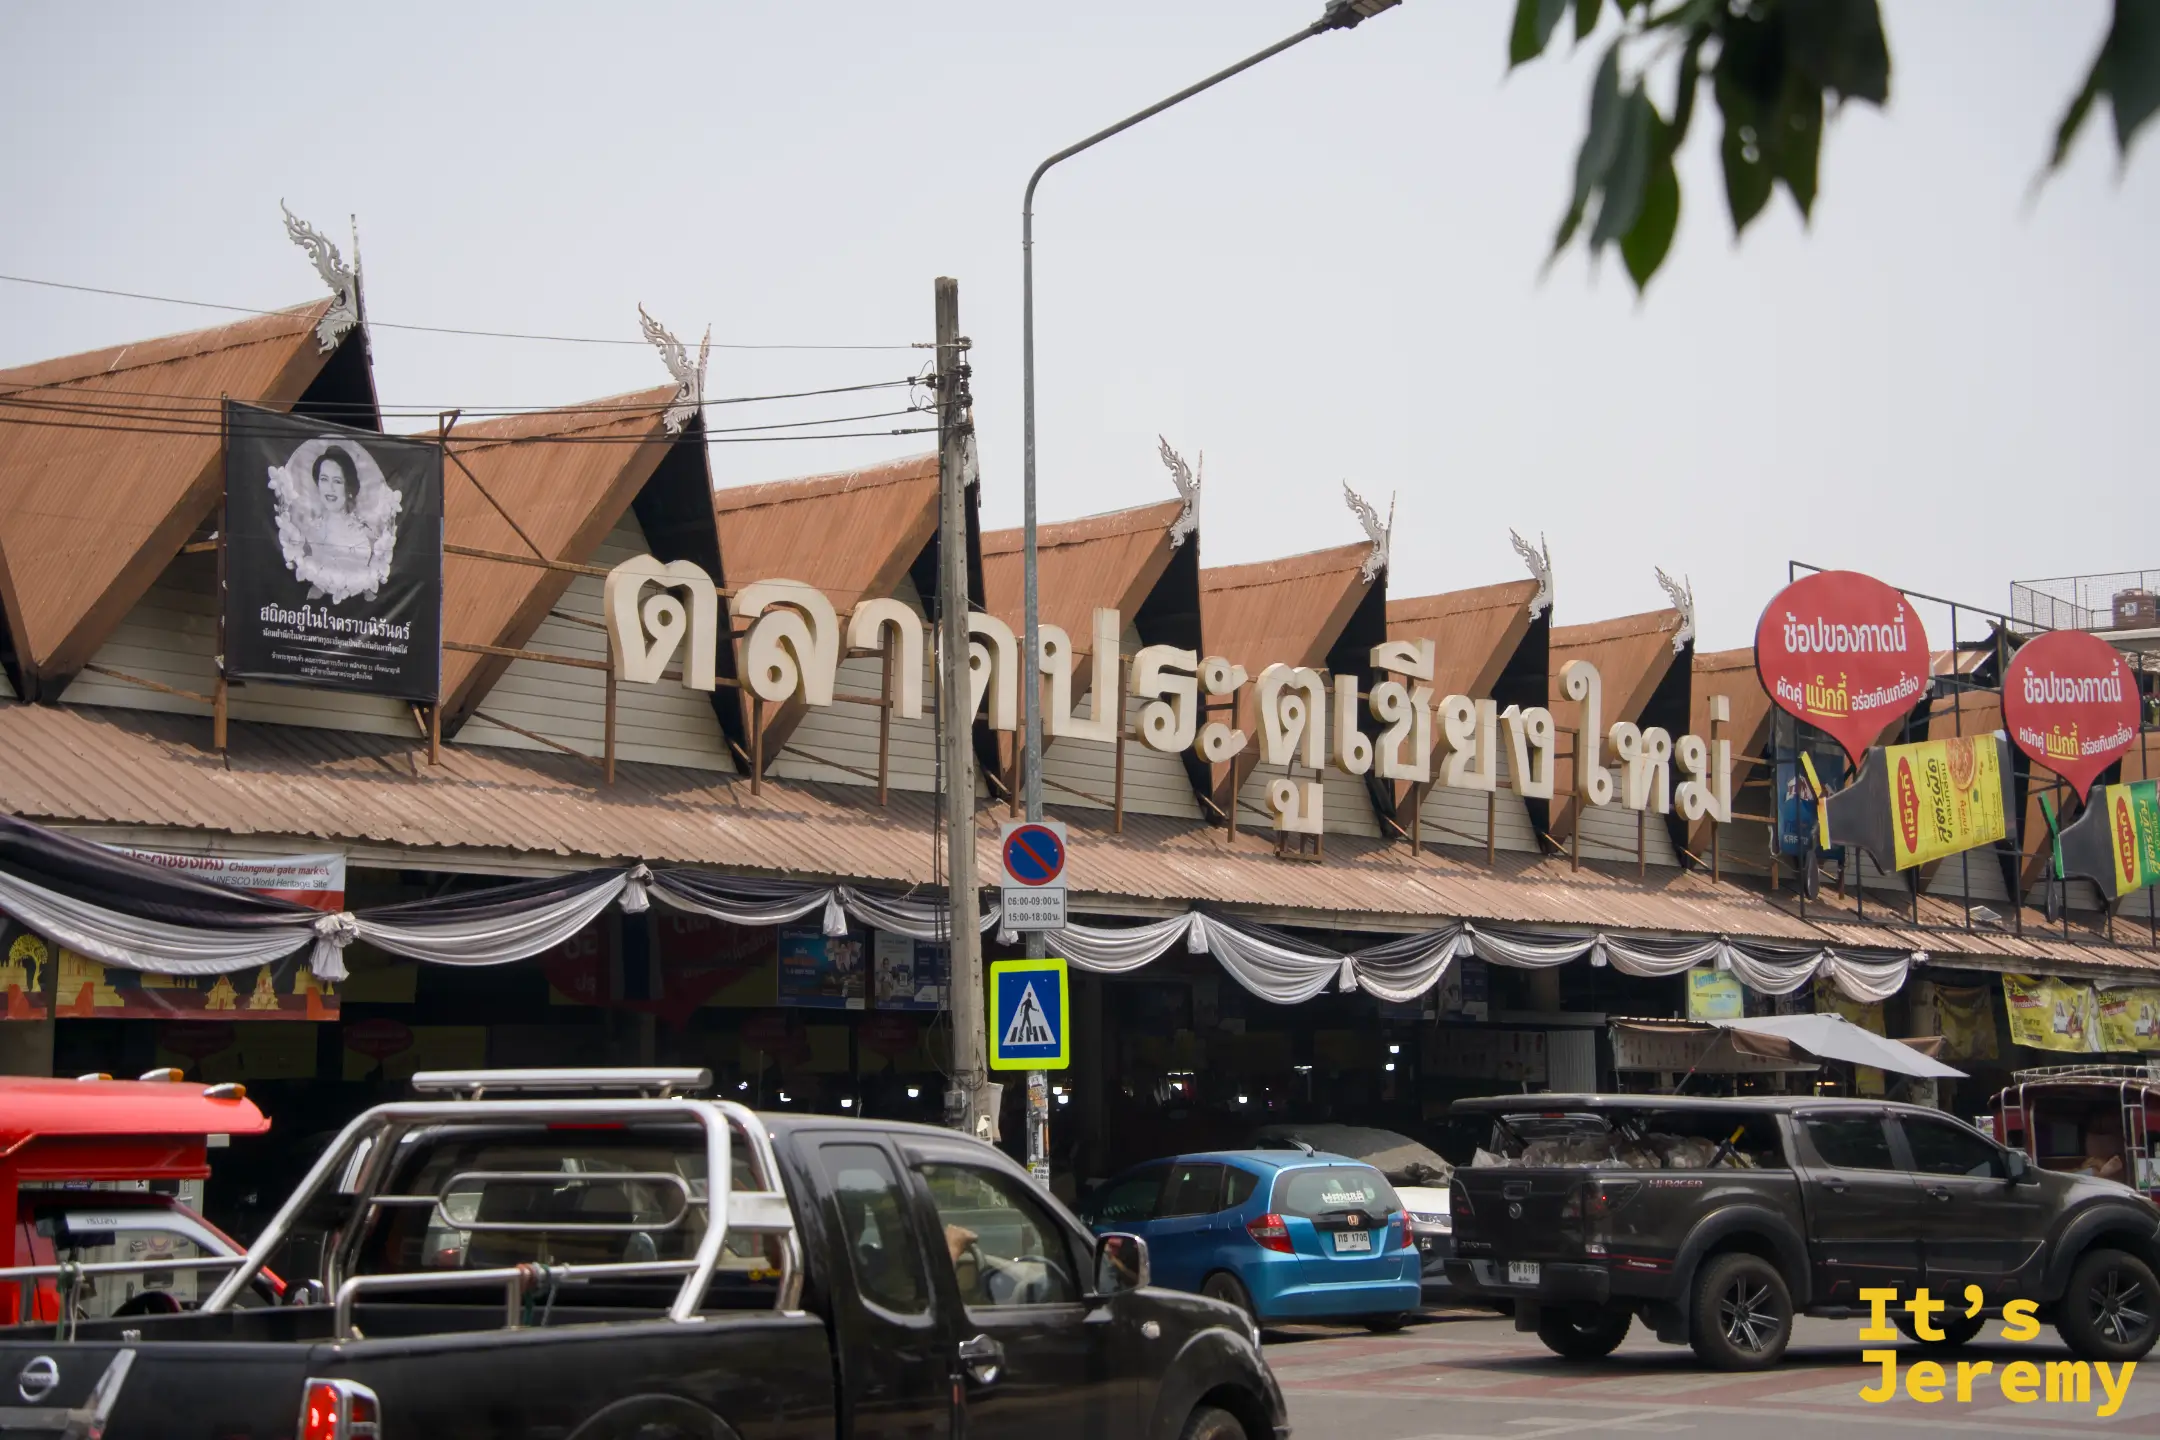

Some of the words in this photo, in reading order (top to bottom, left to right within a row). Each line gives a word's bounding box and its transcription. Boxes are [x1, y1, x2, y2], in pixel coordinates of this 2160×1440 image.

[1783, 603, 1907, 653] ช้อปของกาดนี้
[1805, 671, 1848, 711] แม็กกี้
[2023, 658, 2122, 704] ช้อปของกาดนี้
[2046, 722, 2079, 756] แม็กกี้
[228, 862, 276, 876] Chiangmai
[276, 866, 296, 876] gate
[298, 866, 329, 876] market
[252, 877, 275, 887] World
[276, 878, 311, 890] Heritage
[313, 879, 328, 889] Site
